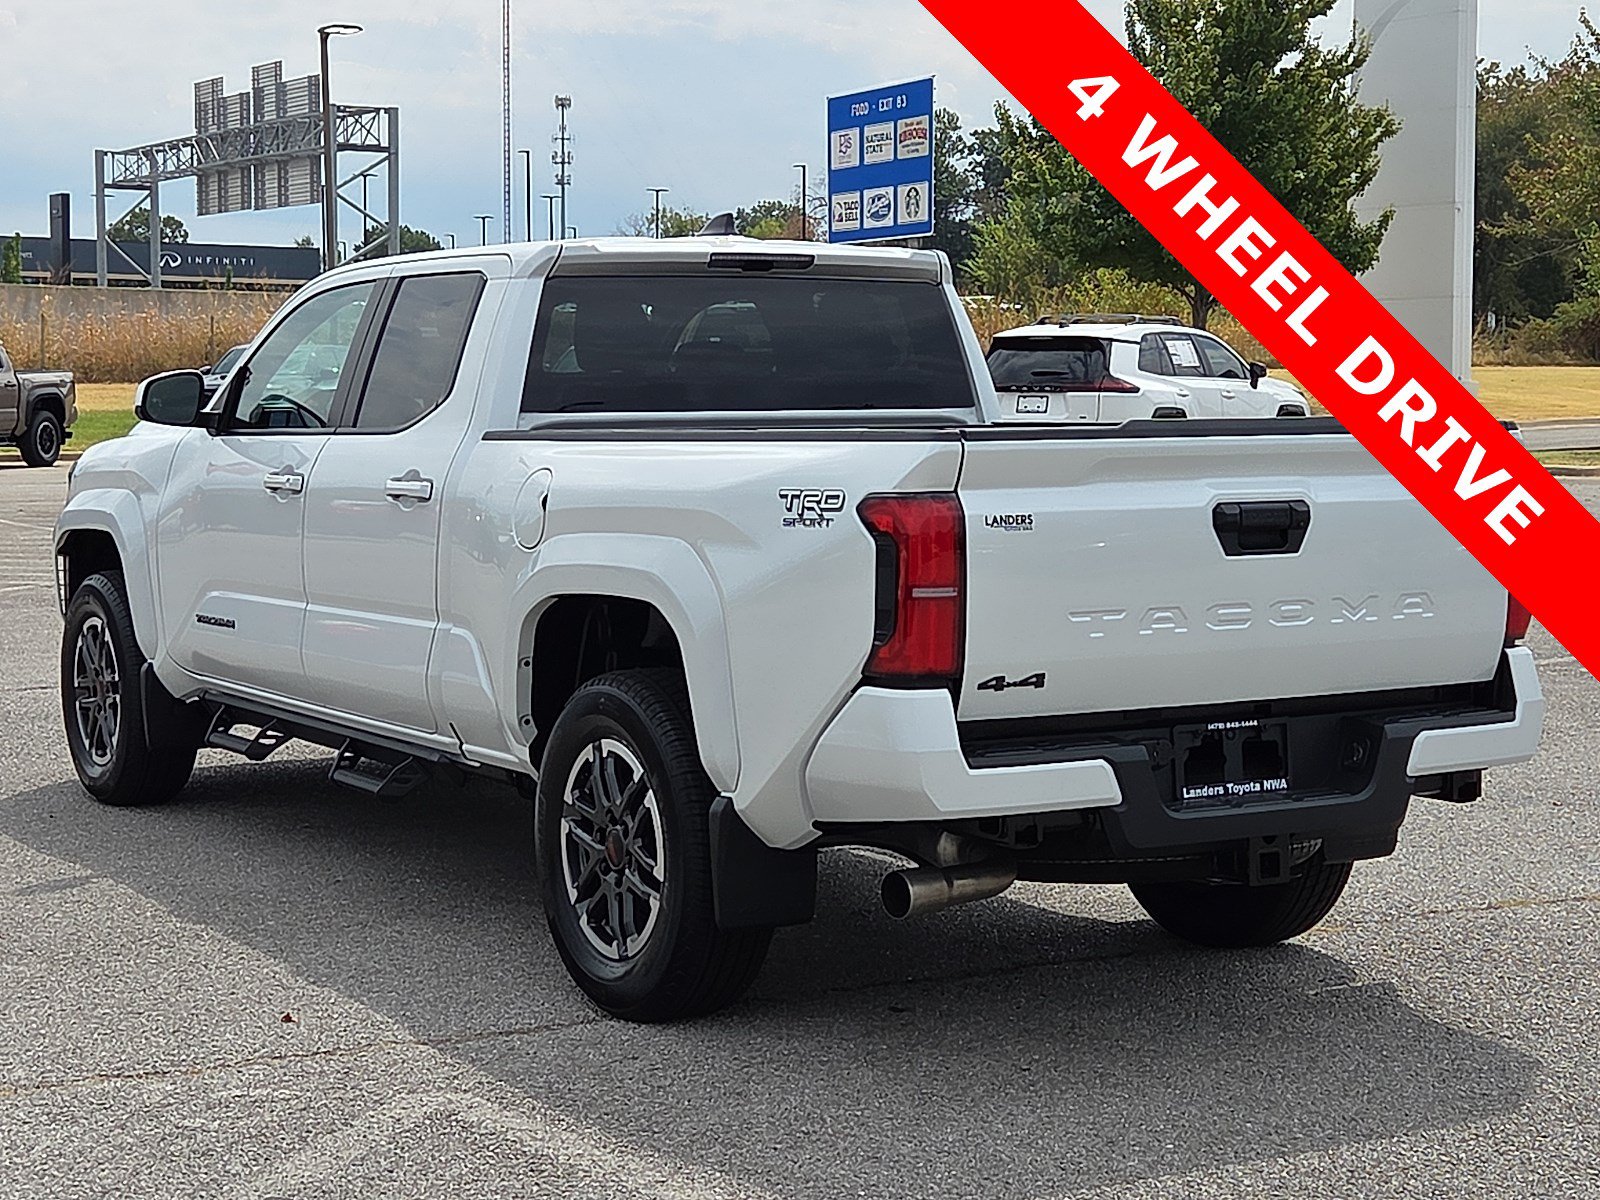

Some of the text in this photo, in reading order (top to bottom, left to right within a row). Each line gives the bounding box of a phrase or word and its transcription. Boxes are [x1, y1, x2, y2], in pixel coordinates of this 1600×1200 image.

[851, 102, 869, 117] FOOD
[879, 97, 893, 111] EXIT
[897, 95, 906, 109] 83
[866, 131, 892, 143] NATURAL
[865, 144, 884, 154] STATE
[843, 200, 859, 211] TACO
[844, 211, 859, 222] BELL
[187, 255, 254, 266] INFINITI
[779, 488, 845, 519] TRD
[782, 517, 835, 528] SPORT
[984, 513, 1034, 528] LANDERS
[1067, 592, 1435, 637] TACOMA
[1182, 779, 1288, 798] Landers Toyota NWA
